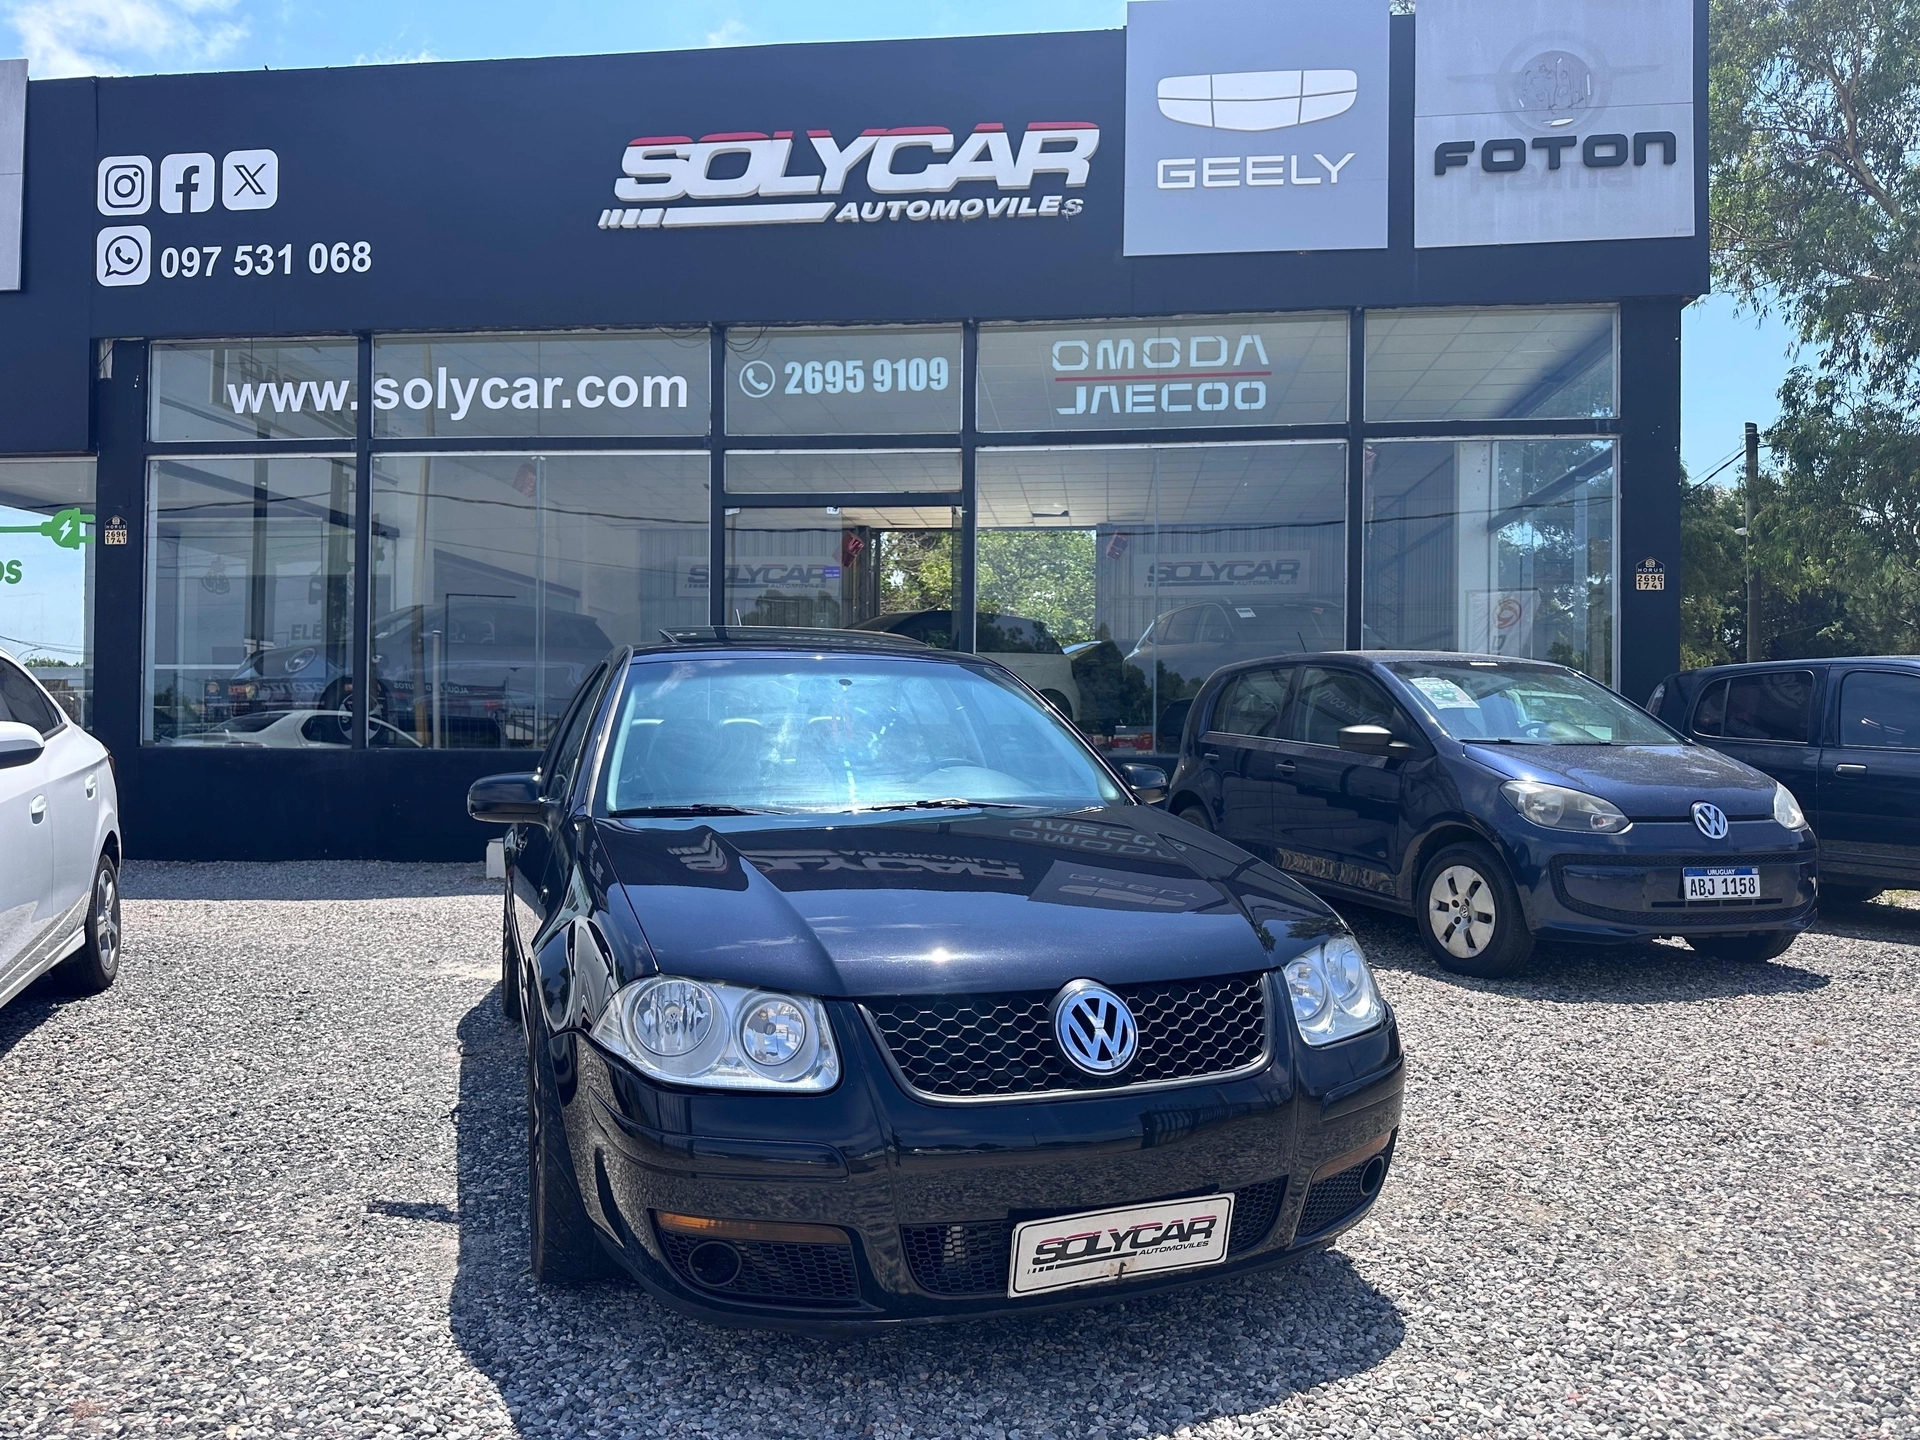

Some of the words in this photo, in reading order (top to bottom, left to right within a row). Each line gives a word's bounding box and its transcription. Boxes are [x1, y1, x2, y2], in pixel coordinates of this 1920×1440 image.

[614, 121, 1100, 202] SOLYCAR
[1157, 152, 1356, 189] GEELY
[1434, 131, 1677, 176] FOTON
[835, 195, 1084, 224] AUTOMOVILES
[160, 246, 222, 279] 097
[233, 243, 292, 276] 531
[308, 241, 372, 274] 068
[1052, 334, 1270, 372] OMODA
[784, 359, 865, 395] 2695
[872, 356, 949, 393] 9109
[1055, 380, 1267, 415] JAECOO
[1147, 559, 1301, 582] SOLYCAR
[1637, 574, 1663, 583] 2696
[1690, 878, 1715, 896] ABJ
[1721, 877, 1756, 896] 1158
[1706, 868, 1736, 876] URUGUAY
[1032, 1215, 1217, 1266] SOLYCAR
[1138, 1240, 1210, 1256] AUTOMOVILES
